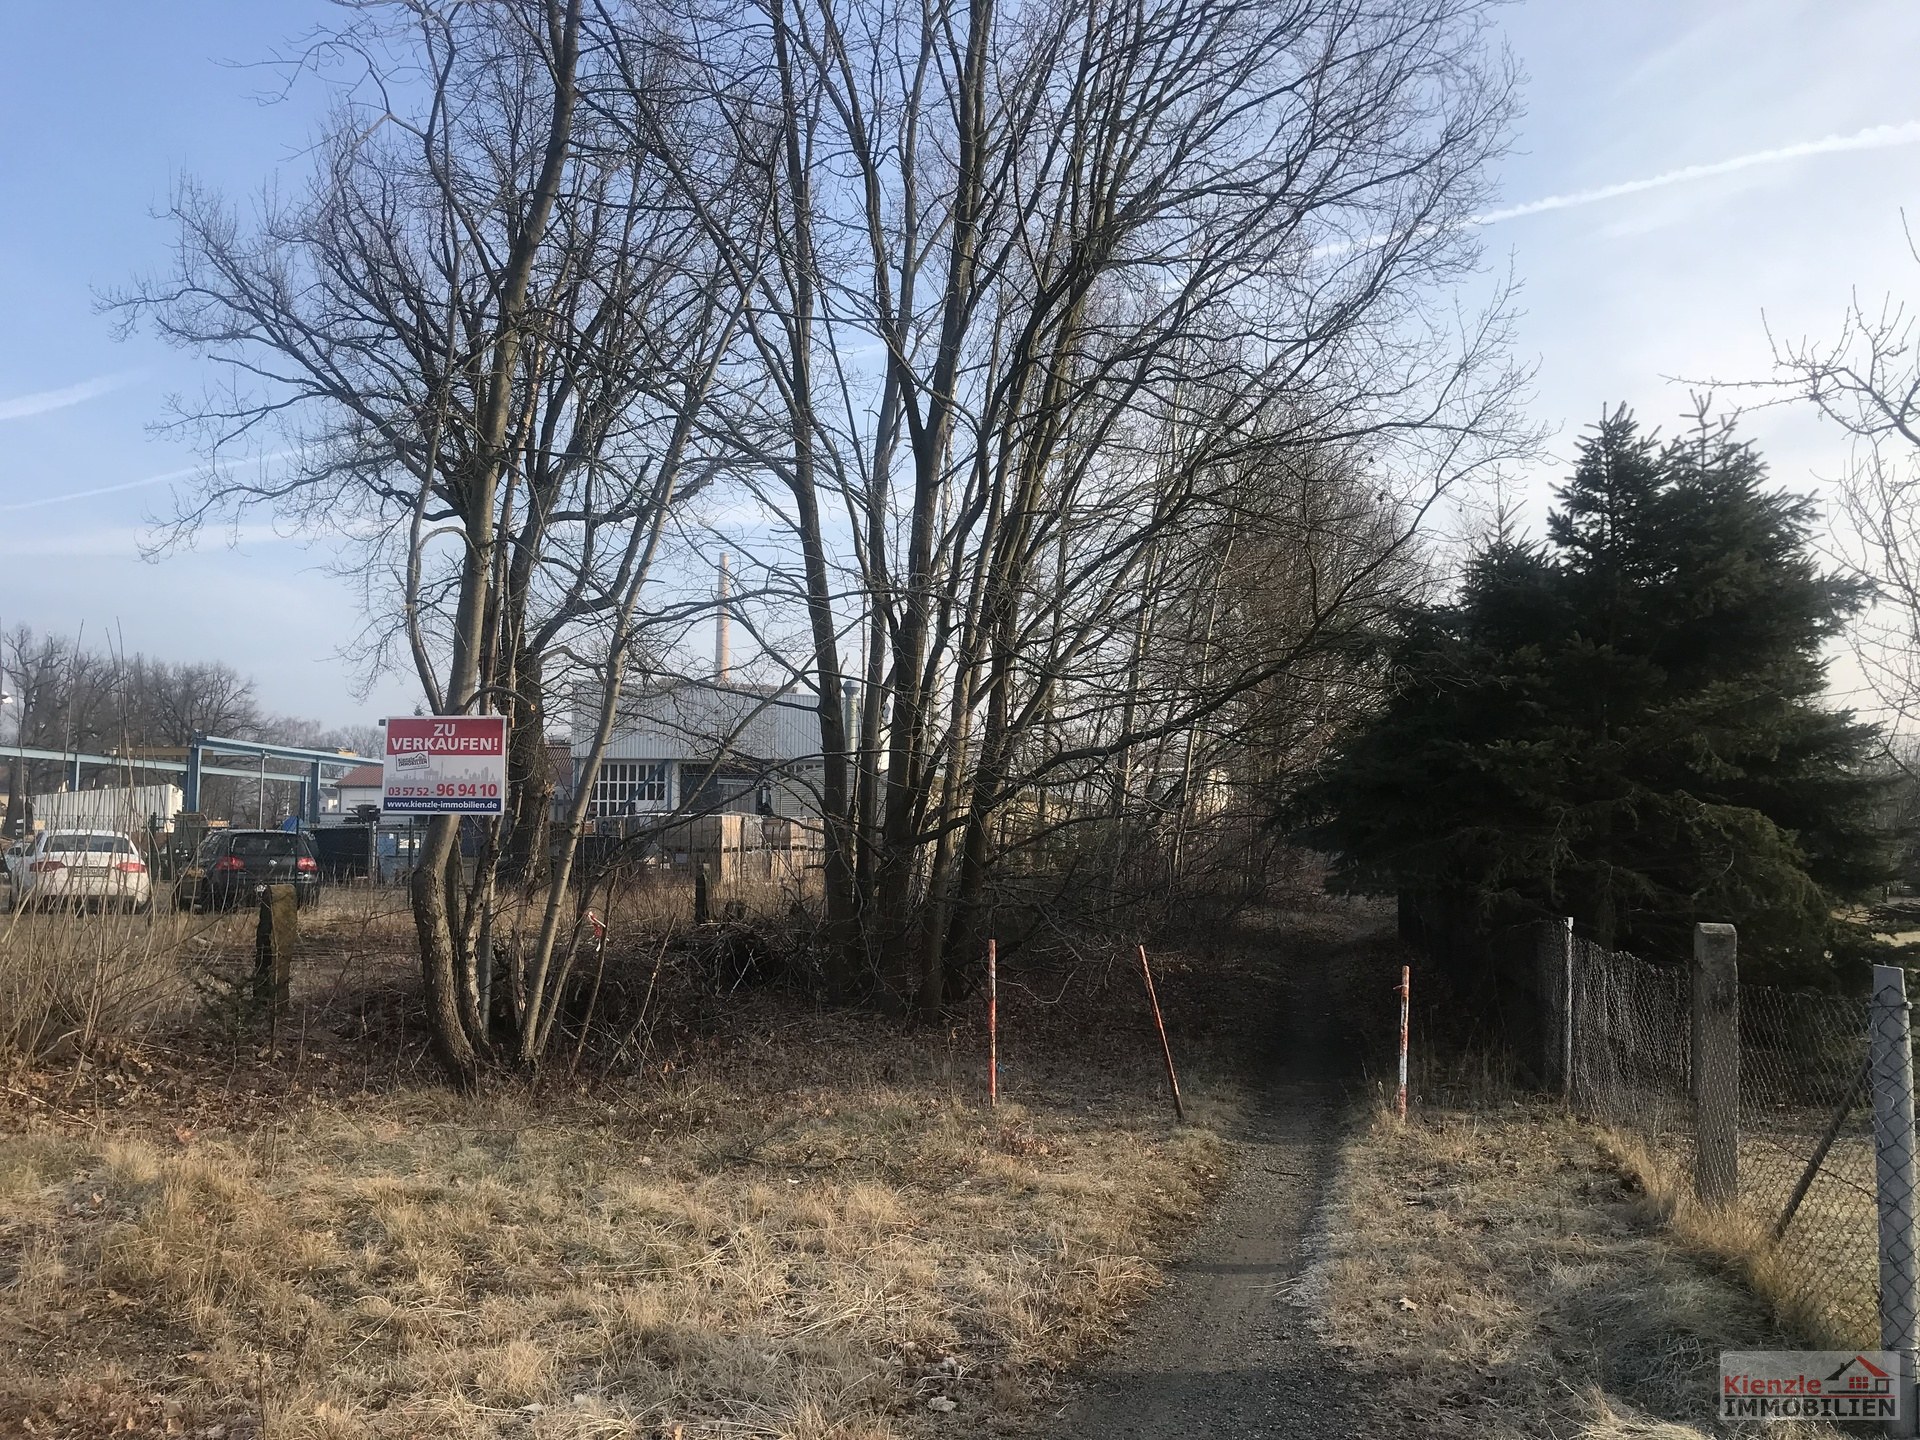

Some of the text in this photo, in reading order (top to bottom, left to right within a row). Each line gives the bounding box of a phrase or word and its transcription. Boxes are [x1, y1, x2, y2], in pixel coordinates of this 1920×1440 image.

[433, 723, 456, 737] ZU
[391, 737, 498, 751] VERKAUFEN!
[388, 787, 401, 796] 03
[402, 787, 414, 796] 57
[416, 787, 429, 796] 52
[436, 783, 455, 797] 96
[457, 783, 477, 797] 94
[479, 783, 498, 797] 10
[387, 800, 498, 809] www.kienzle-immobilien.de
